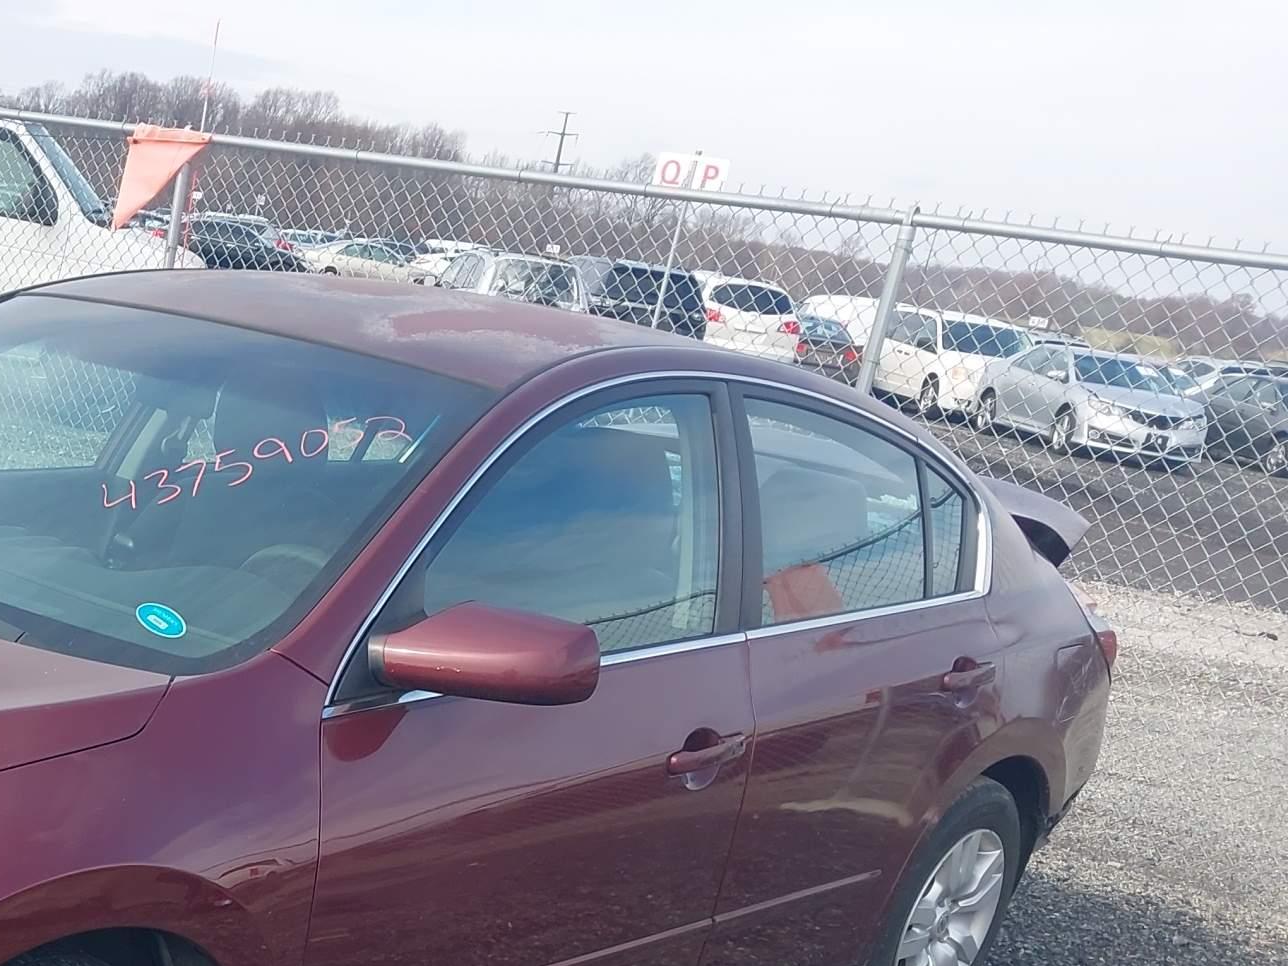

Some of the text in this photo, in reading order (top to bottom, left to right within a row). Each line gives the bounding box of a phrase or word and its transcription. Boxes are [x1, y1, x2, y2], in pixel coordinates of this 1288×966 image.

[660, 160, 720, 189] Q P
[101, 416, 412, 509] 43759052
